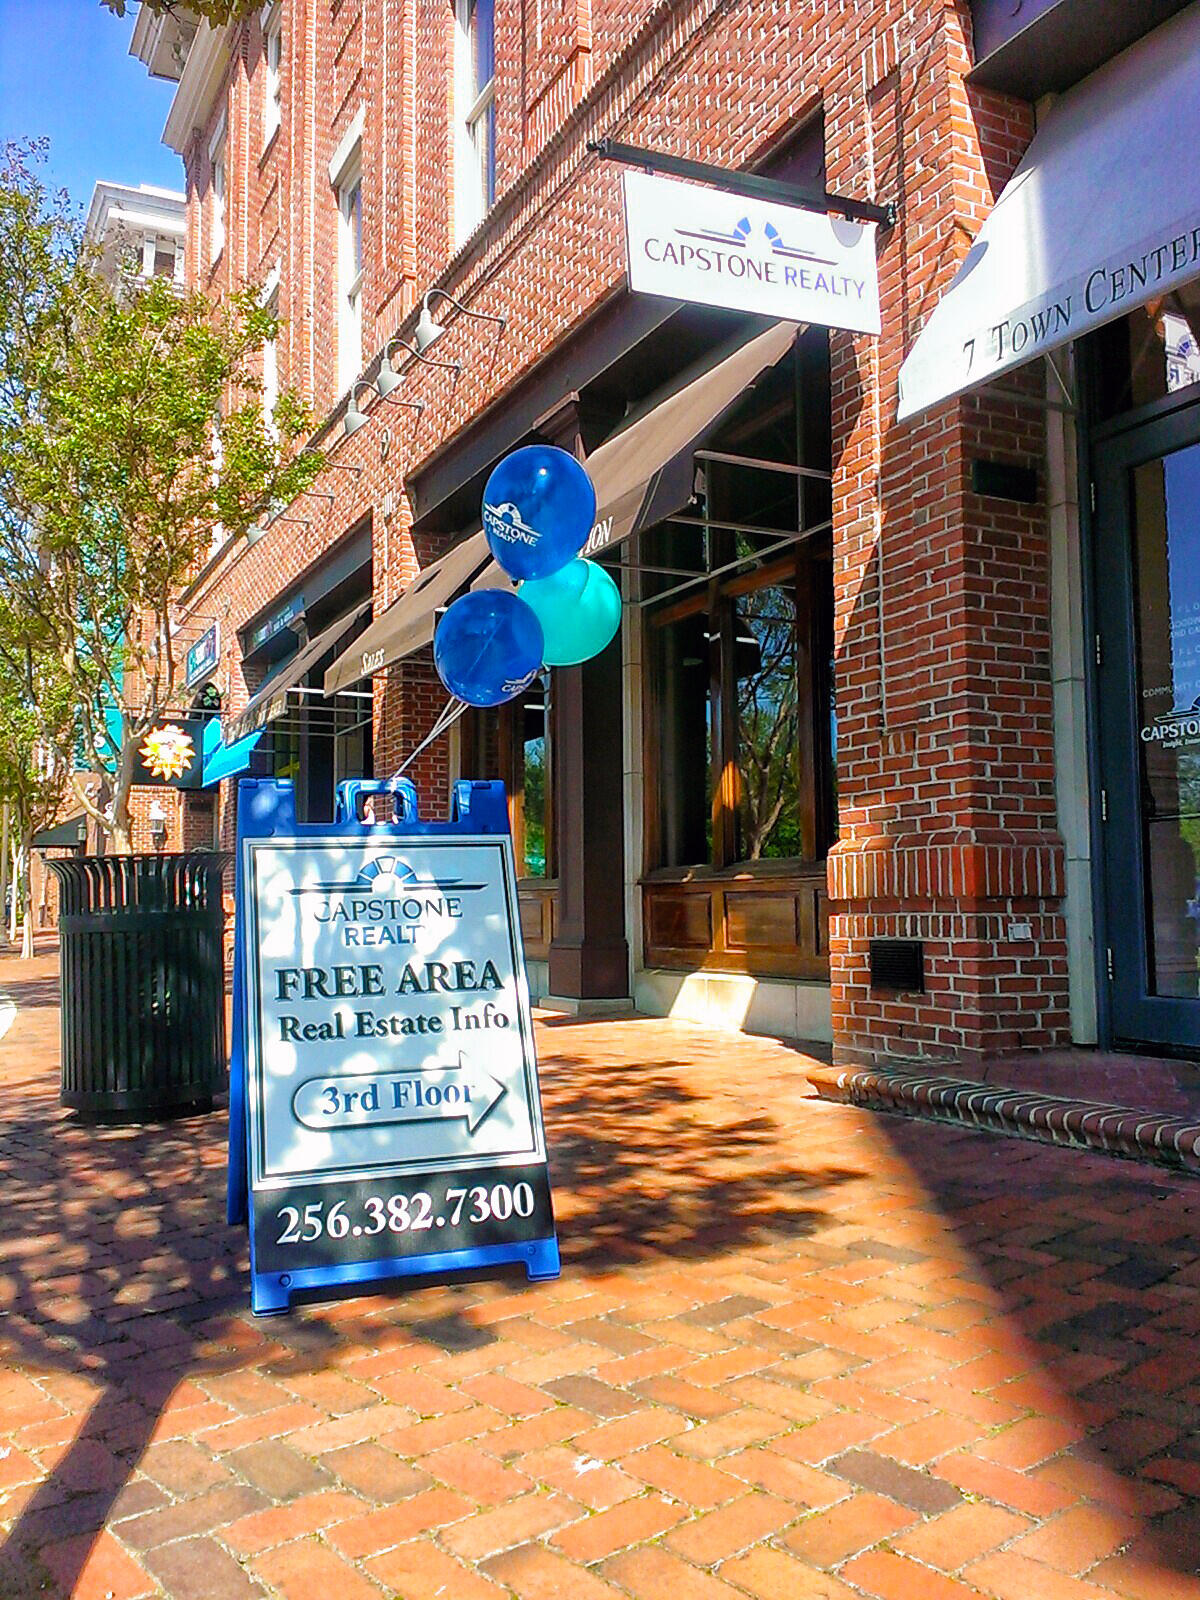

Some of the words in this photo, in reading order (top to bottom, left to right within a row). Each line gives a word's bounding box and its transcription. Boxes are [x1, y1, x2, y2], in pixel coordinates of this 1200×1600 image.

[644, 238, 778, 285] CAPSTONE
[784, 266, 865, 299] REALTY
[962, 338, 976, 375] 7
[992, 296, 1072, 361] TOWN
[484, 510, 538, 547] CAPSTONE
[578, 516, 613, 557] ION
[1140, 720, 1200, 742] CAPSTO
[313, 897, 464, 923] CAPSTONE
[344, 924, 428, 946] REALT
[274, 964, 387, 1001] FREE
[395, 959, 505, 995] AREA
[278, 1011, 346, 1042] Real
[354, 1010, 443, 1038] Estate
[450, 1002, 510, 1031] Info
[322, 1083, 381, 1115] 3rd
[391, 1080, 475, 1110] Floor
[276, 1182, 535, 1244] 256.382.7300
